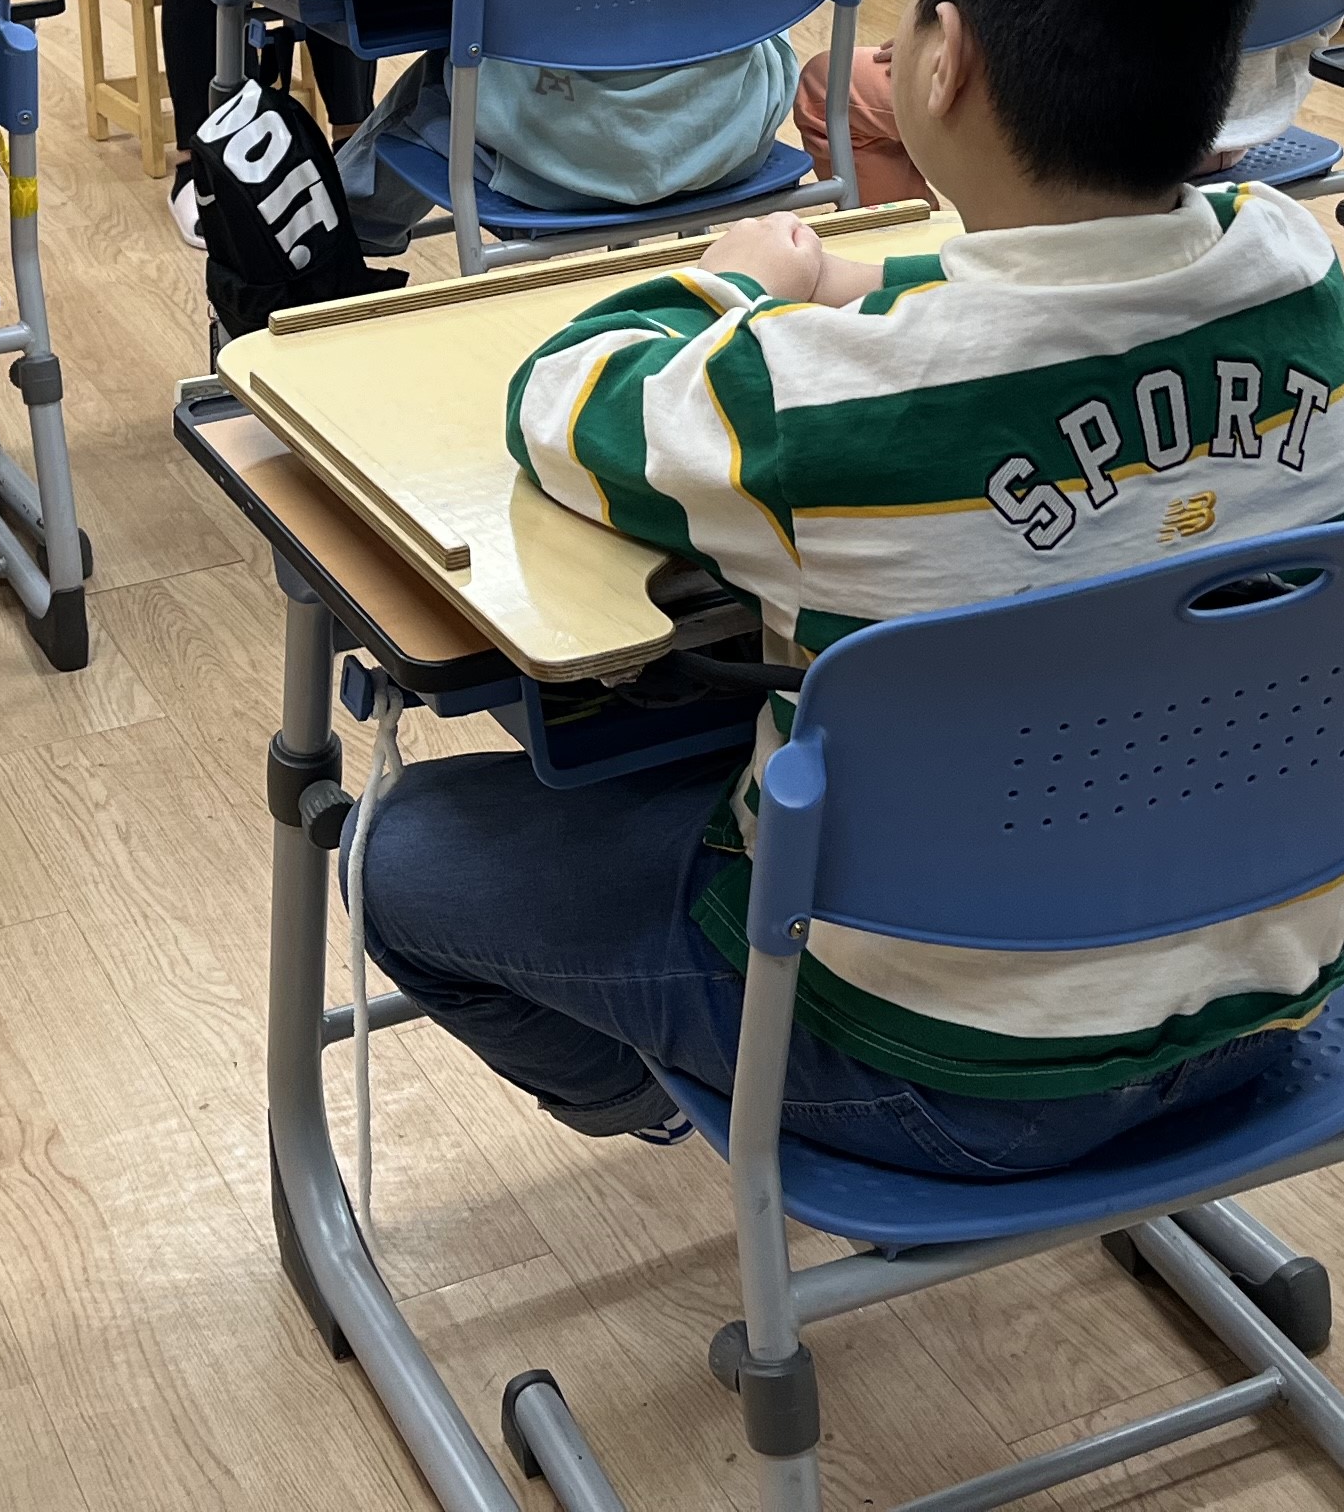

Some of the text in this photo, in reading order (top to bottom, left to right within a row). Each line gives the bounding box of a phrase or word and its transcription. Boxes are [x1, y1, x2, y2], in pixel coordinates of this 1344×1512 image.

[197, 79, 338, 270] DO IT.
[985, 360, 1329, 551] SPORT
